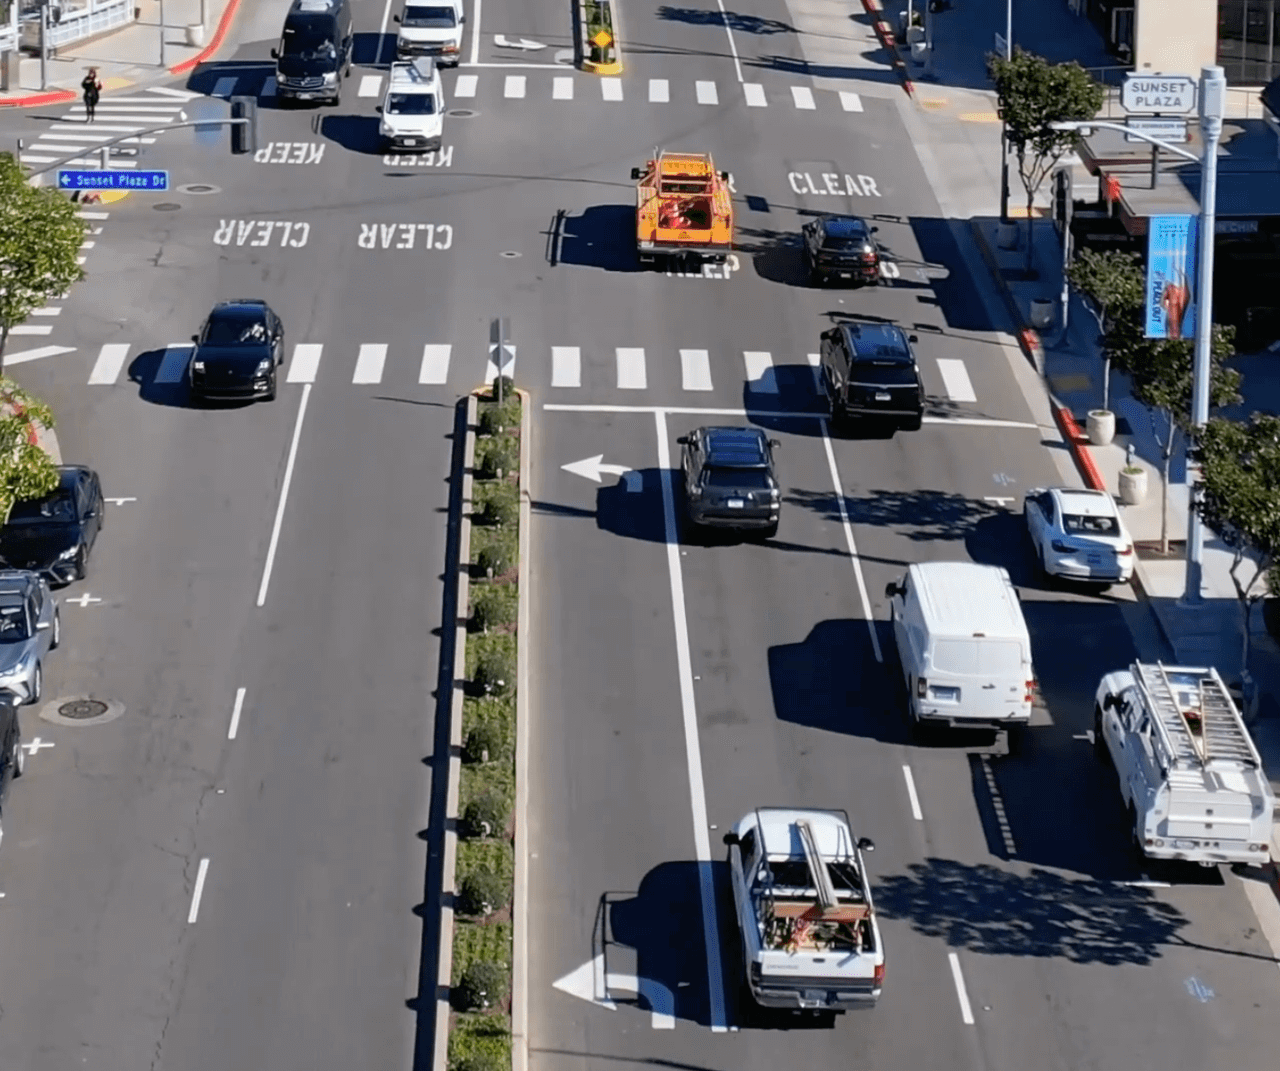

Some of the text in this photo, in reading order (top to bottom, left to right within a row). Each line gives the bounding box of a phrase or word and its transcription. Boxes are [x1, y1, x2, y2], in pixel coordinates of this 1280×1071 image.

[1131, 82, 1187, 93] SUNSET
[1136, 96, 1182, 107] PLAZA
[253, 142, 325, 164] KEEP
[76, 174, 166, 186] Sunset Plaza Dr
[788, 172, 882, 197] CLEAR
[213, 219, 310, 247] CLEAR
[358, 223, 453, 250] CLEAR
